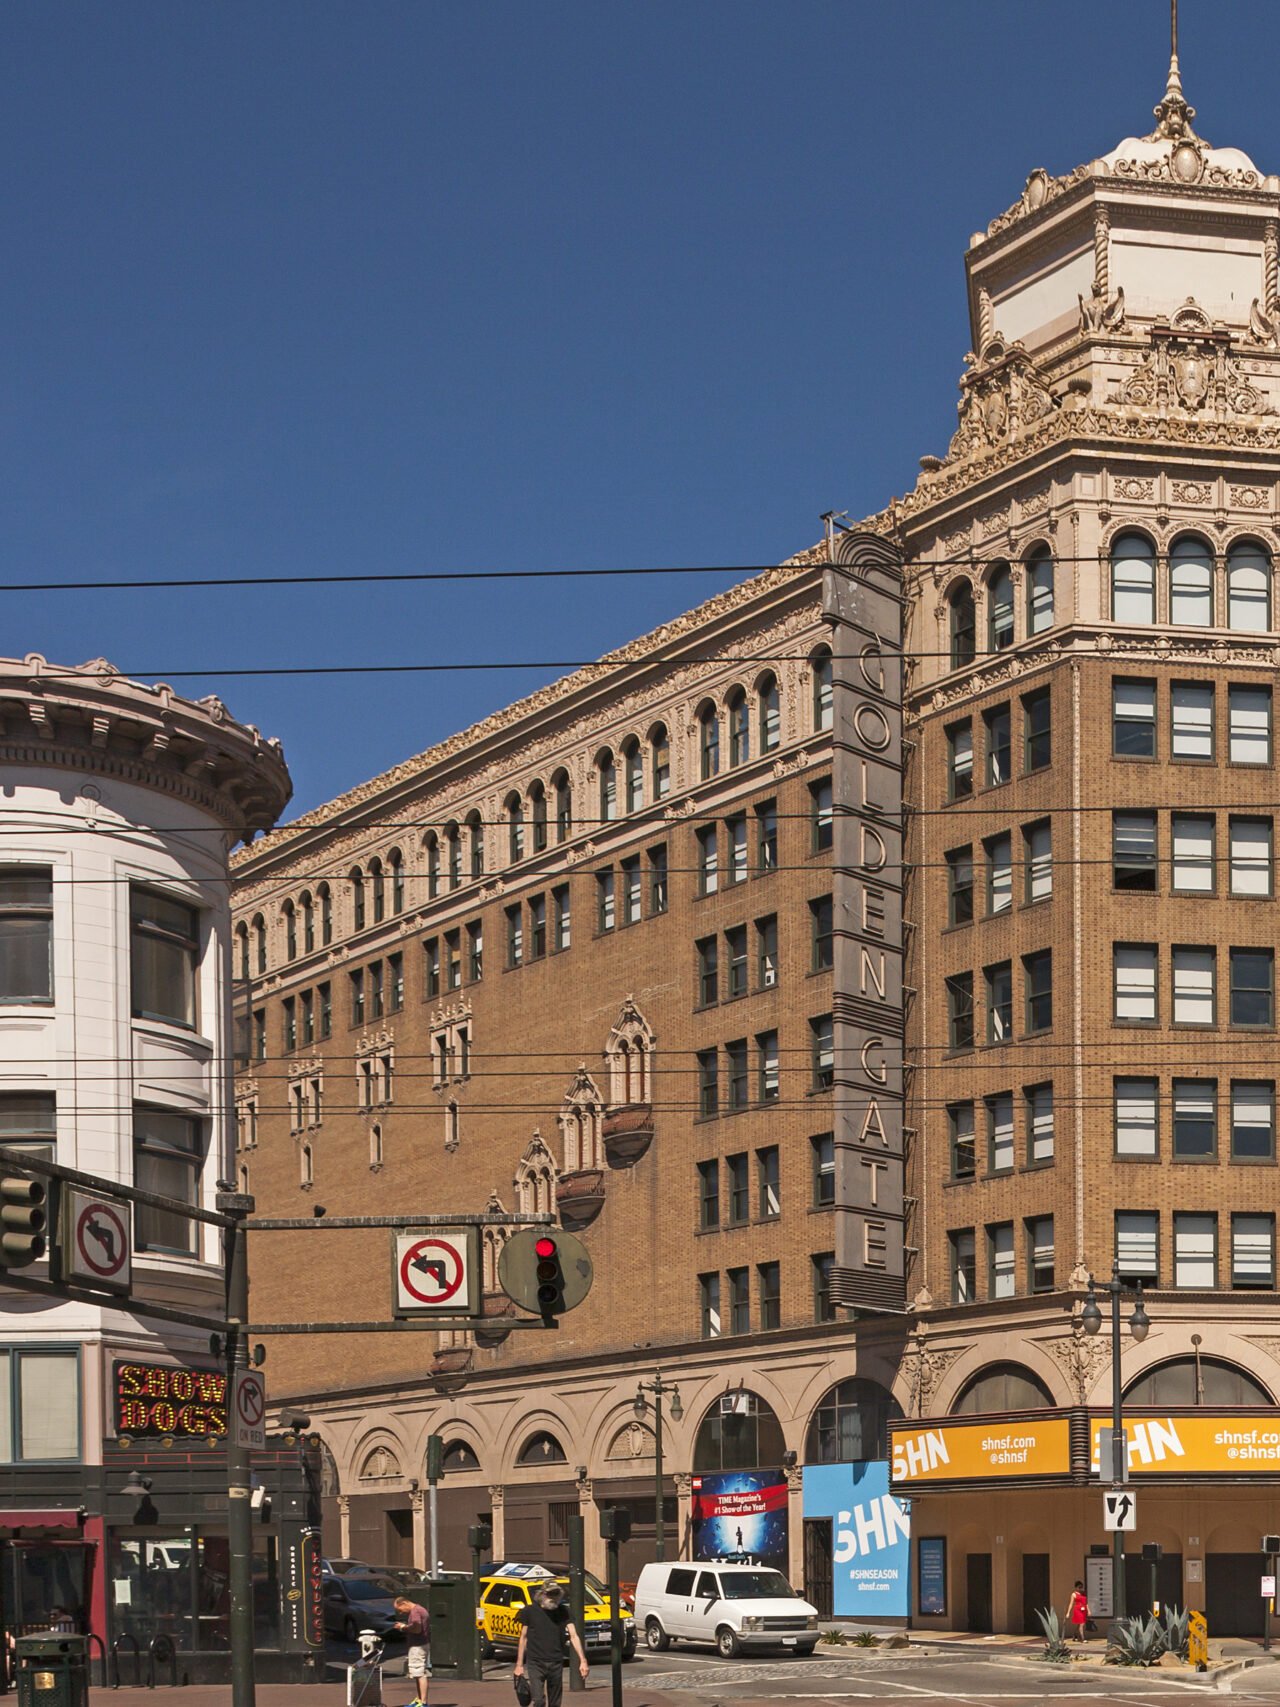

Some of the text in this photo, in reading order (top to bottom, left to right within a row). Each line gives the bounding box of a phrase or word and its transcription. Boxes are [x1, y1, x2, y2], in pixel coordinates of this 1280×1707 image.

[854, 642, 891, 1270] GOLDEN GATE
[118, 1365, 228, 1403] SHOW
[119, 1398, 228, 1435] DOGS
[982, 1435, 1035, 1450] shnsf.com
[892, 1428, 950, 1481] SHN
[990, 1449, 1028, 1464] @shnsf
[717, 1494, 761, 1504] TIME Magazine's
[752, 1503, 766, 1511] Year!
[833, 1493, 911, 1564] SHN
[850, 1569, 899, 1579] #SHNSEASON
[858, 1582, 890, 1591] shnsf.com
[491, 1614, 523, 1635] 333-333
